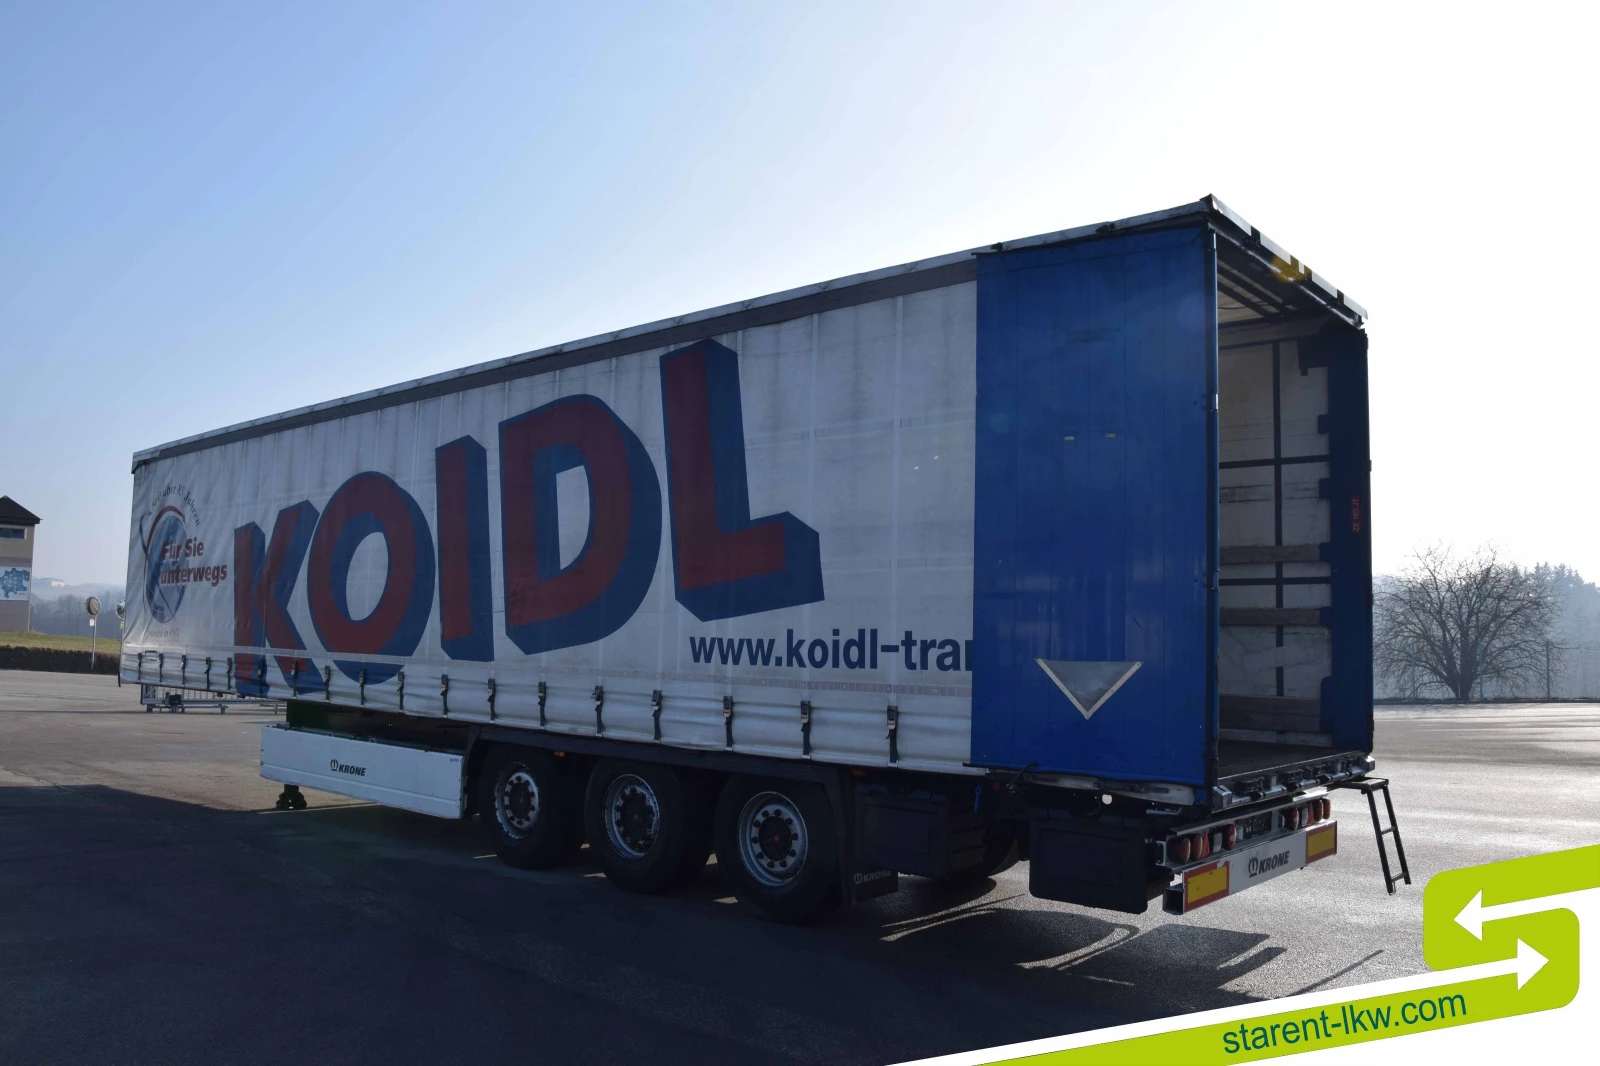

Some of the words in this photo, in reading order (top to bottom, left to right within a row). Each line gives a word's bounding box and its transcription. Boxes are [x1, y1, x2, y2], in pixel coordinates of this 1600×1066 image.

[234, 338, 825, 698] KOIDL
[161, 540, 183, 561] Für
[184, 536, 204, 558] Sie
[160, 564, 228, 587] unterwegs
[338, 763, 366, 776] KRONE
[1258, 850, 1290, 875] KRONE
[863, 869, 892, 883] KRONE
